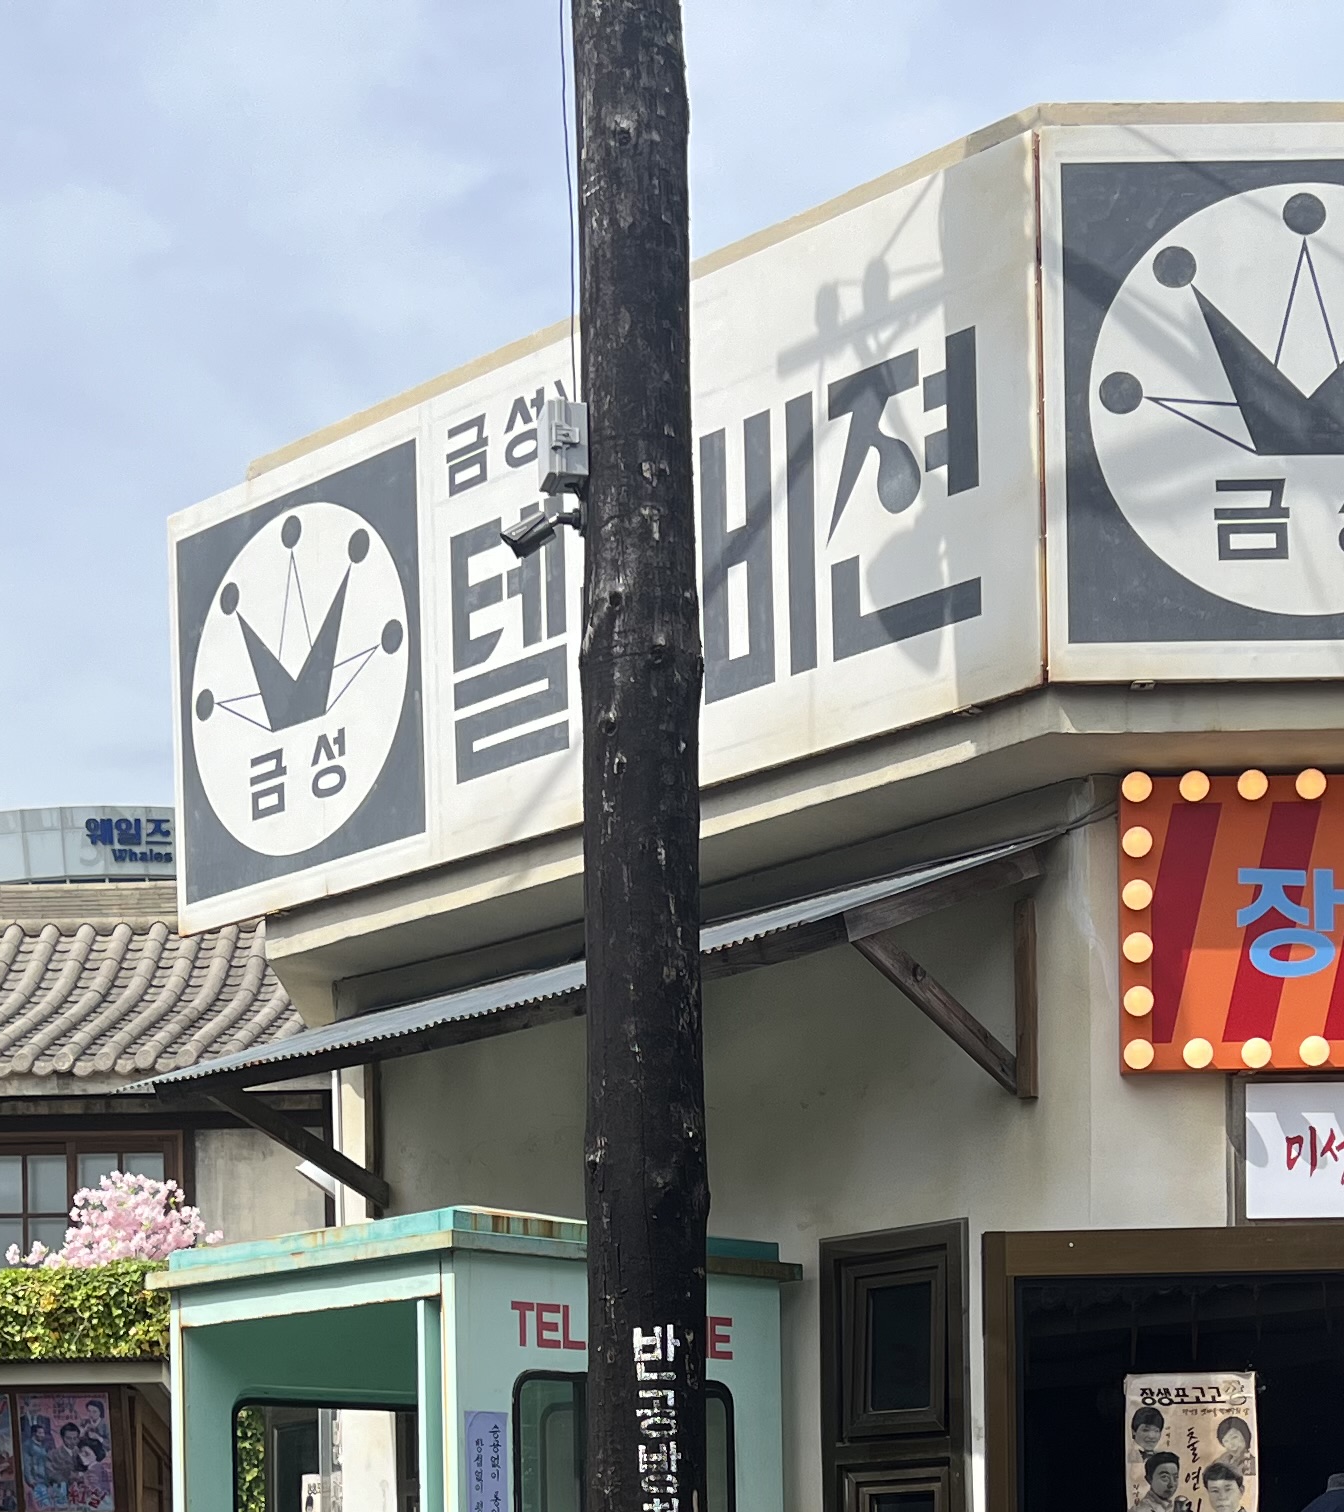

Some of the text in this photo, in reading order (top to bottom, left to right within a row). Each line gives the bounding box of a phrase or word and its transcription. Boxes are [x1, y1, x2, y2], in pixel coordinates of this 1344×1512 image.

[449, 325, 982, 785] 텔비젼
[249, 726, 347, 822] 금성
[85, 817, 173, 846] 웨일즈
